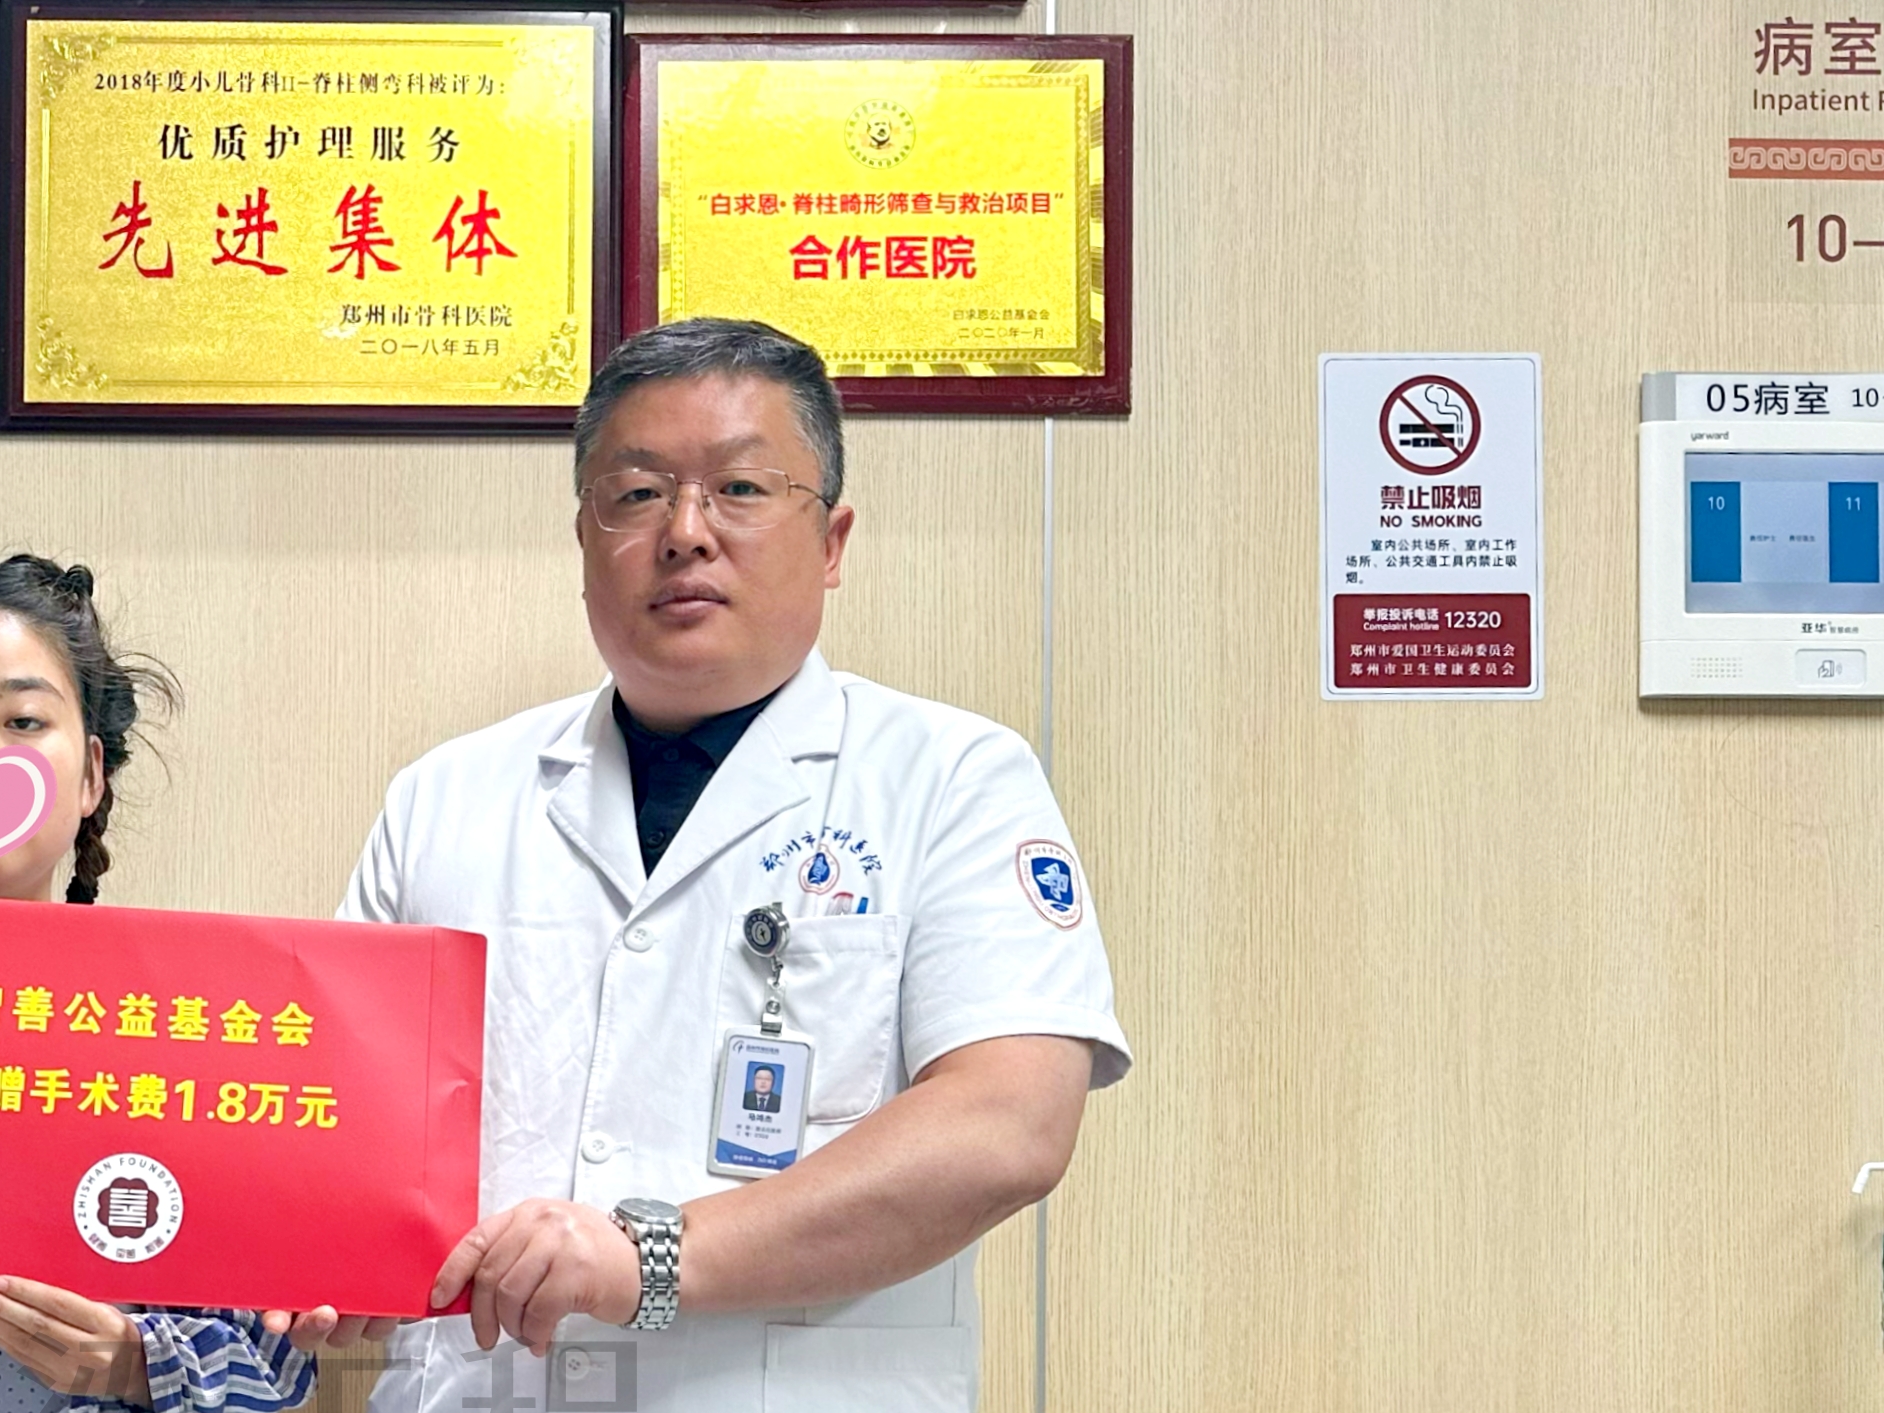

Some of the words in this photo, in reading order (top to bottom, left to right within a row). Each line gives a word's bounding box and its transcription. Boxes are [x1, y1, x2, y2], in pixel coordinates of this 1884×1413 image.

[1754, 16, 1882, 76] 病室
[1753, 88, 1870, 116] Inpatient
[158, 124, 461, 163] 优质护理服务
[98, 180, 518, 279] 先进集体
[789, 234, 977, 280] 合作医院
[339, 304, 513, 329] 郑州市骨科医院
[1707, 381, 1831, 416] 05病室
[1380, 485, 1482, 510] 禁止吸烟
[1708, 496, 1726, 511] 10
[1846, 497, 1861, 511] 11
[1380, 515, 1402, 528] NO
[1411, 515, 1483, 528] SMOKING
[1363, 608, 1439, 621] 举报投诉电话
[1444, 611, 1502, 629] 12320
[1410, 622, 1439, 631] hotline
[1350, 643, 1516, 657] 郑州市爱国卫生运动委员会
[1349, 662, 1516, 676] 郑州市卫生健康委员会
